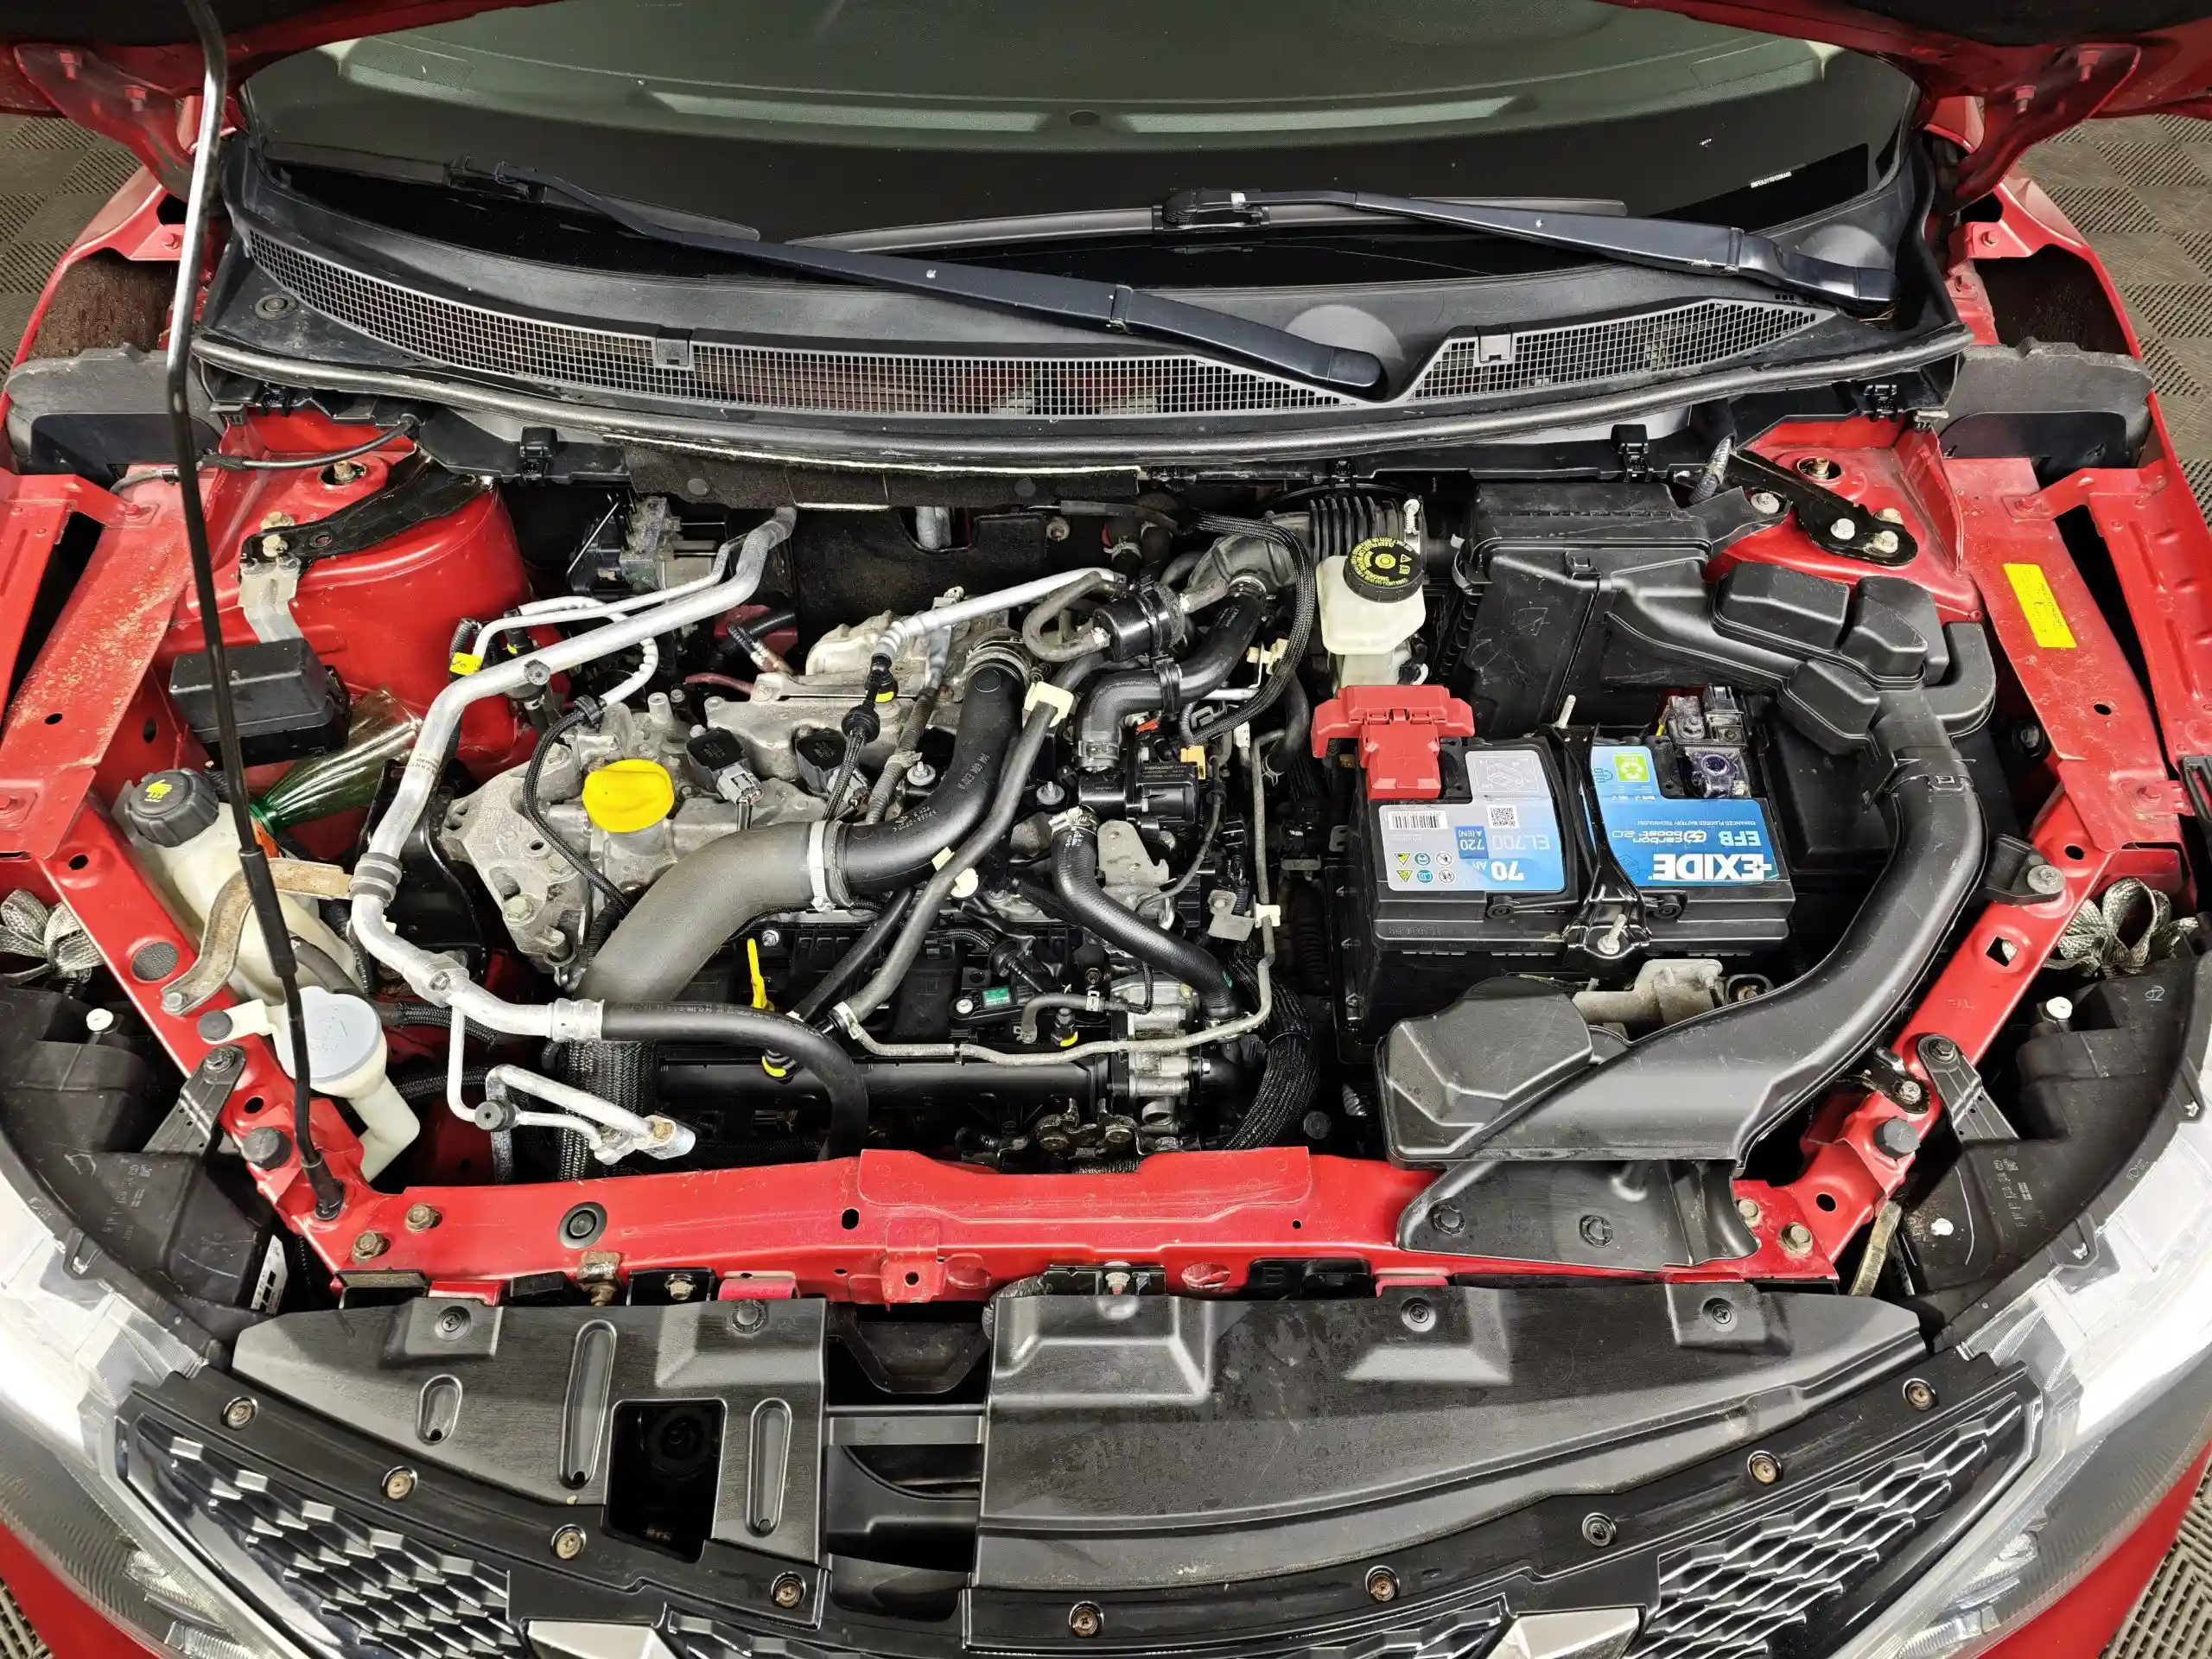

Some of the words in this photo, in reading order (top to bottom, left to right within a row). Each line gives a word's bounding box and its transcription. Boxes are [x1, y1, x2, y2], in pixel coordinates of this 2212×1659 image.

[1460, 839, 1485, 851] 720
[1492, 834, 1551, 851] EL700
[1718, 830, 1762, 847] EFB
[1472, 861, 1487, 871] Ah
[1491, 861, 1525, 881] 70
[1652, 854, 1772, 880] EXIDE
